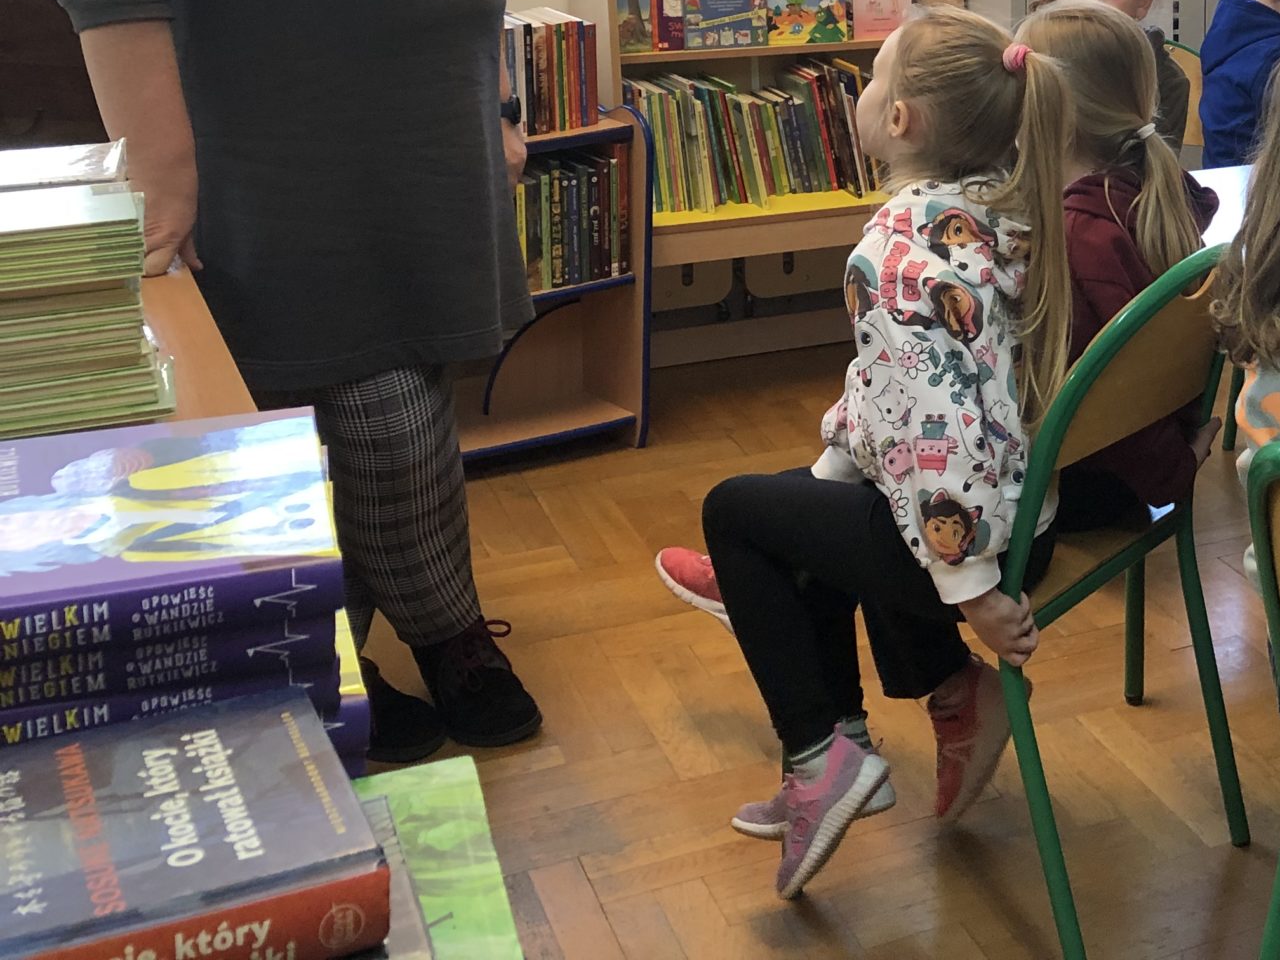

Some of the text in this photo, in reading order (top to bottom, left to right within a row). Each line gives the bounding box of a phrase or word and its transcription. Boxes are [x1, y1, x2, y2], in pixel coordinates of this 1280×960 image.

[902, 260, 929, 302] GIRL
[0, 601, 109, 640] WIELKIM
[132, 611, 224, 640] RUTKIEWICZ
[144, 599, 215, 626] WANDZIE
[0, 651, 103, 688] WIELKIM
[127, 661, 217, 690] RUTKIEWICZ
[139, 649, 208, 675] WANDZIE
[2, 704, 109, 745] WIELKIM
[137, 747, 181, 798] który
[180, 728, 266, 861] ratował książki
[55, 742, 127, 917] SOSUKE NATSUKAWA
[150, 792, 199, 851] kocie,
[167, 848, 205, 868] O
[173, 918, 272, 960] który
